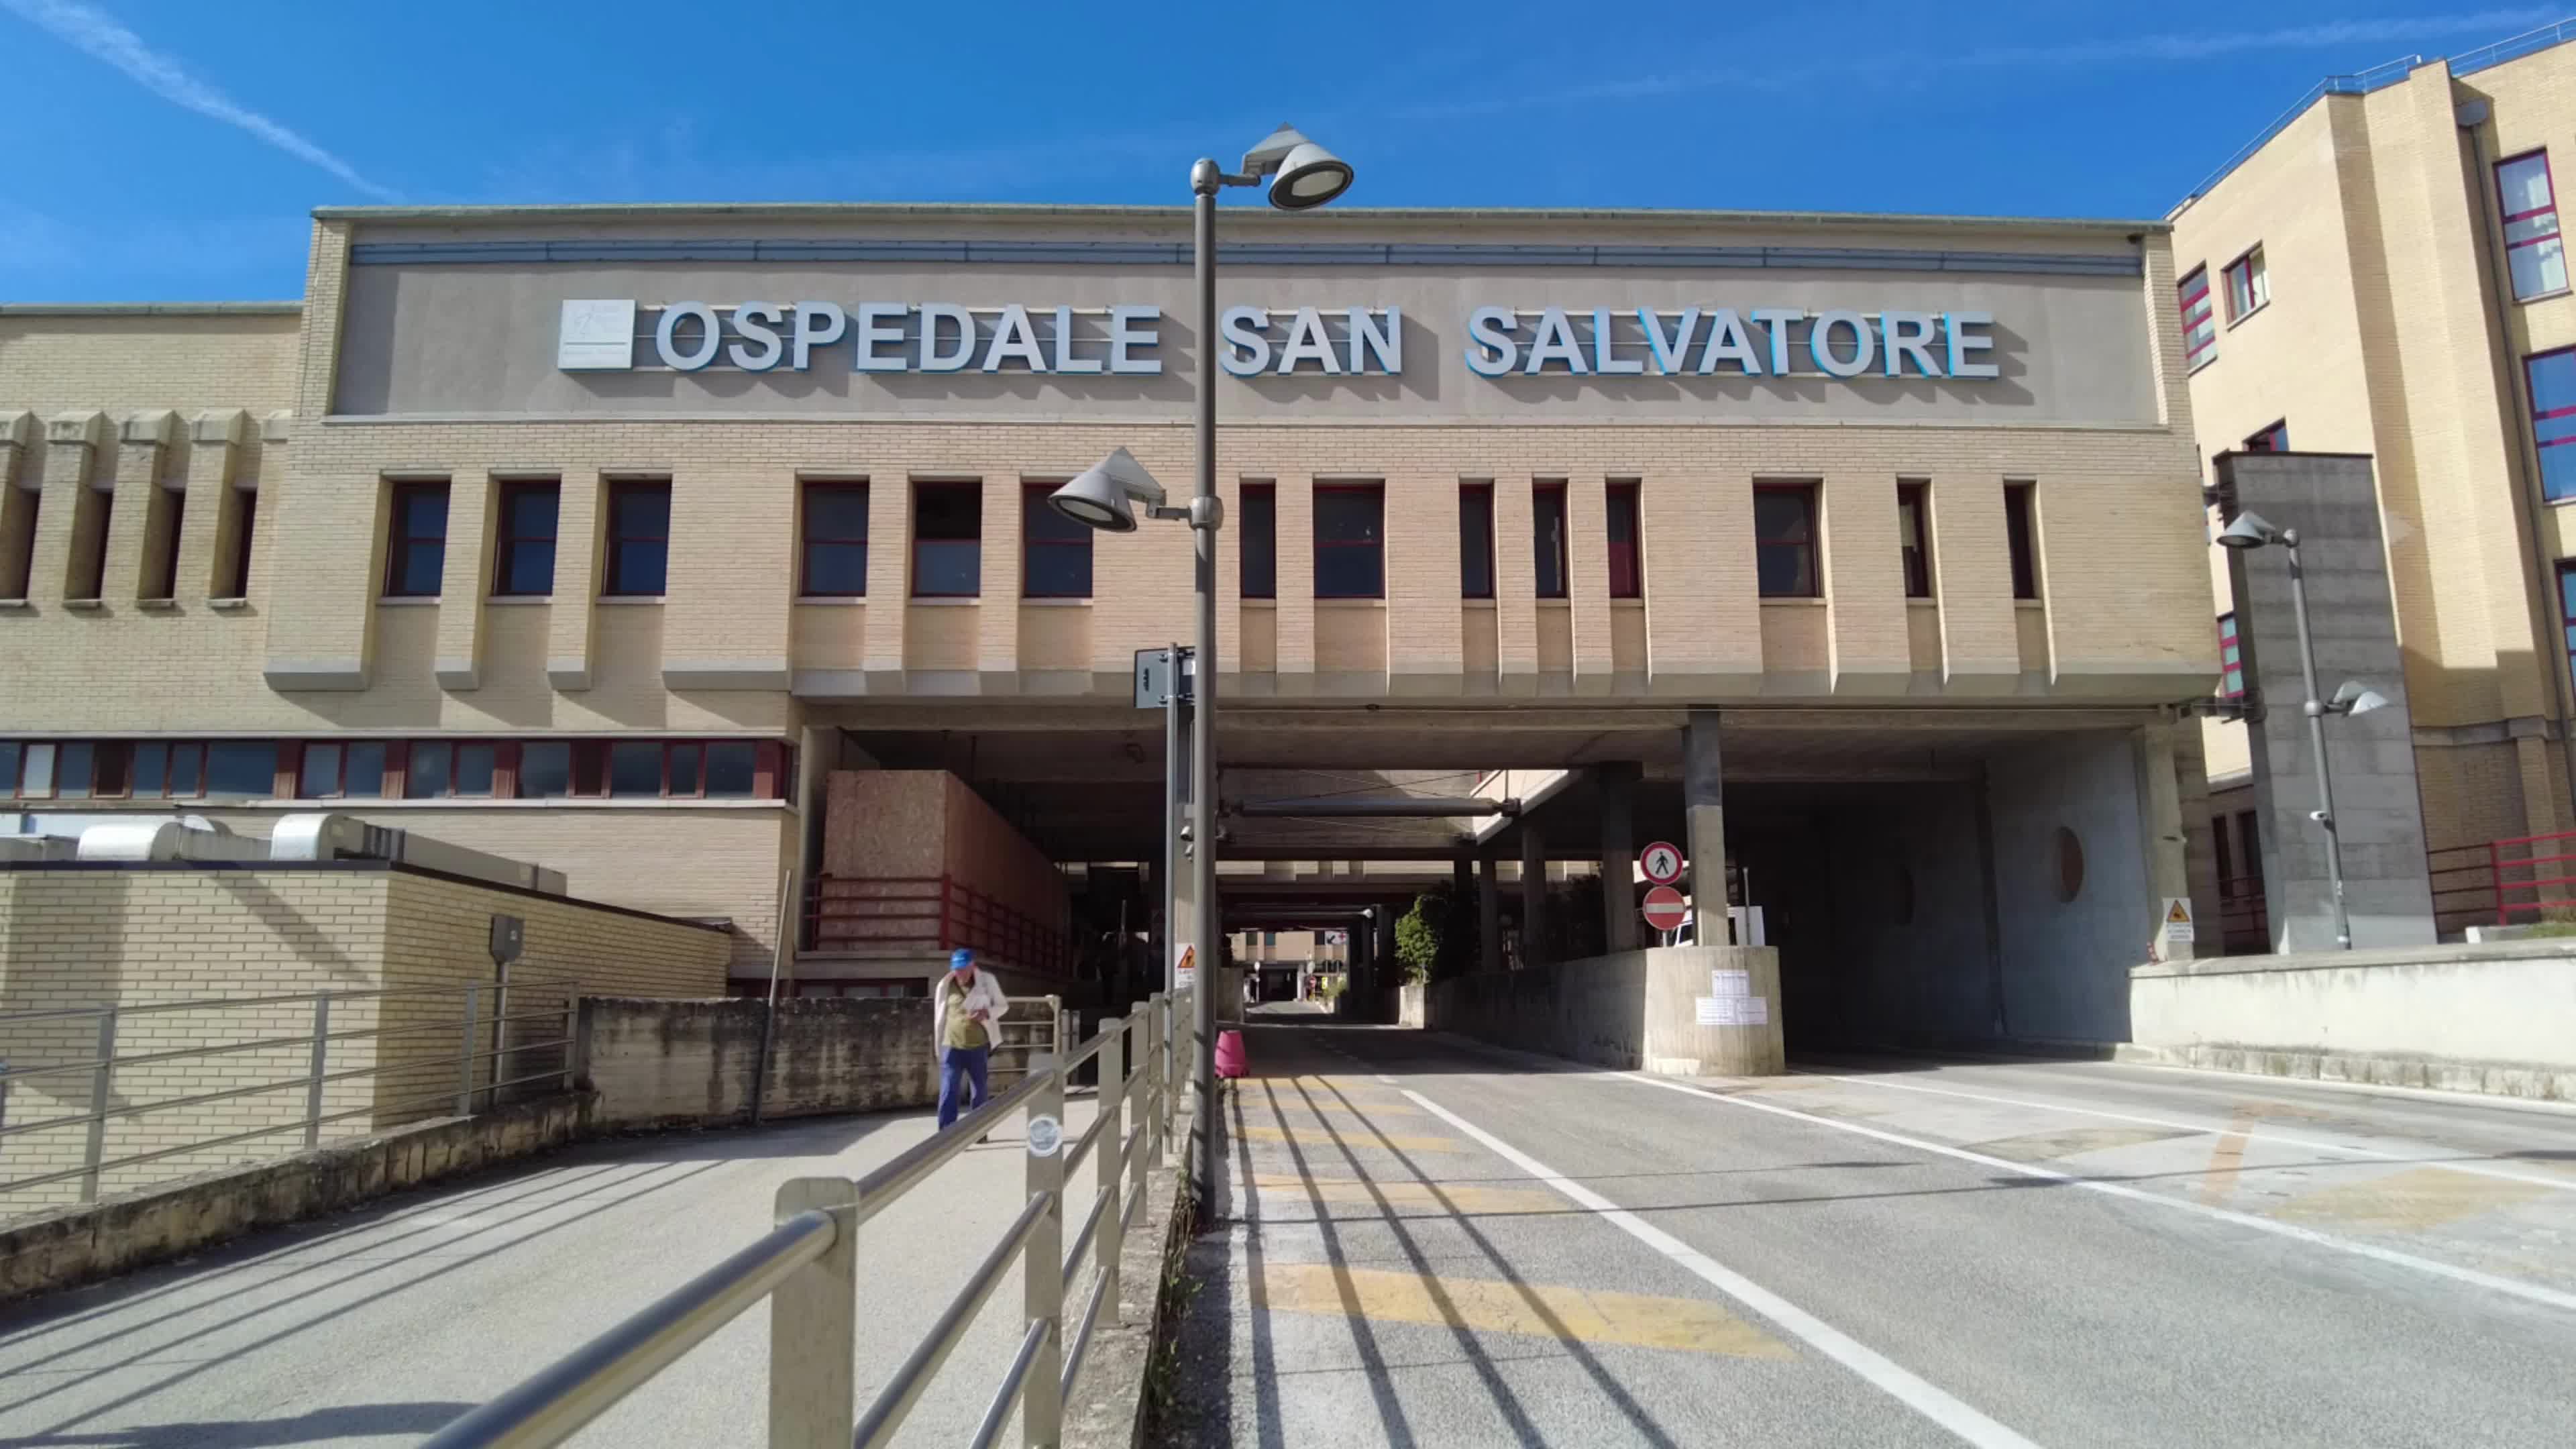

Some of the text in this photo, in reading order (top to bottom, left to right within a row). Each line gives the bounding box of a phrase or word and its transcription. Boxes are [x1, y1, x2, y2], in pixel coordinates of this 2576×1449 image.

[655, 301, 1162, 374] OSPEDALE
[1220, 305, 1401, 377] SAN
[1464, 305, 2000, 378] SALVATORE
